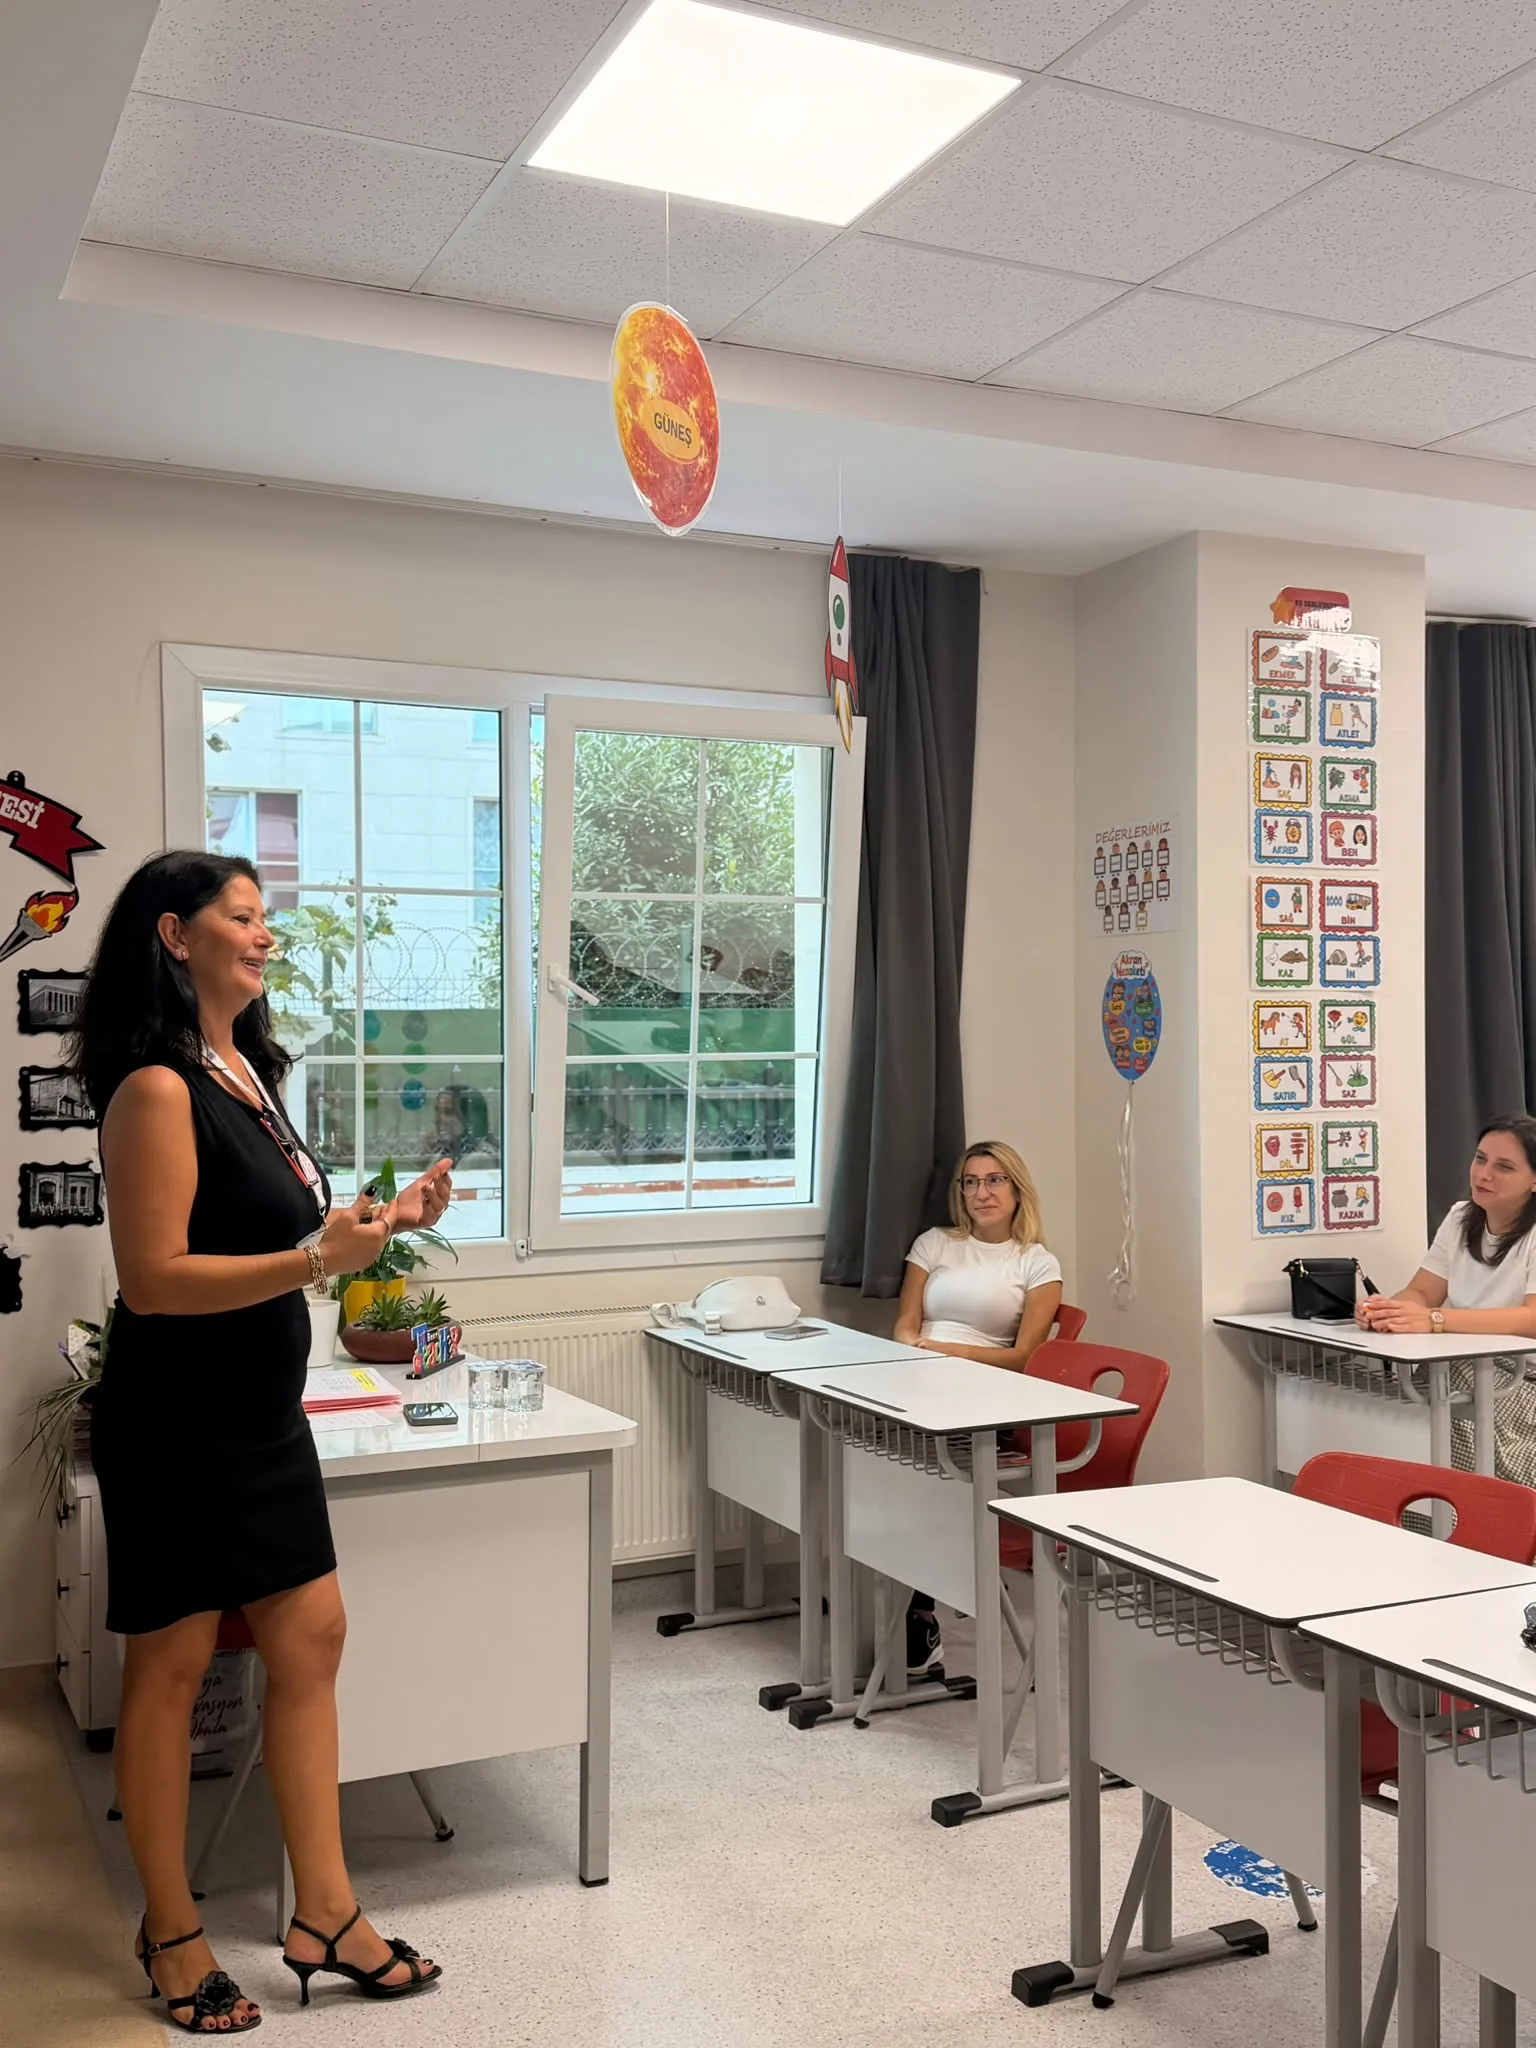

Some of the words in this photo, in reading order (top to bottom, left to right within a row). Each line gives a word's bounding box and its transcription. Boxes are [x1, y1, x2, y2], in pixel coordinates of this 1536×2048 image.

[654, 412, 692, 448] GÜNEŞ
[1269, 670, 1296, 679] EKMEK
[1337, 729, 1360, 739] ATLET
[0, 790, 45, 829] ESİ
[1095, 820, 1171, 844] DEĞERLERİMİZ
[1272, 846, 1299, 855] AKREP
[1341, 848, 1358, 857] BEN
[1279, 913, 1294, 923] SAĞ
[1341, 915, 1356, 924] BİN
[1120, 954, 1142, 965] Akran
[1278, 969, 1294, 978] KAZ
[1346, 968, 1356, 979] İN
[1279, 1038, 1289, 1046] AT
[1273, 1091, 1296, 1101] SATIR
[1341, 1090, 1357, 1098] SAZ
[1279, 1158, 1294, 1169] DİL
[1342, 1158, 1357, 1166] DAL
[1280, 1214, 1295, 1223] KIZ
[1339, 1211, 1364, 1219] KAZAN
[193, 1696, 244, 1720] vasyon
